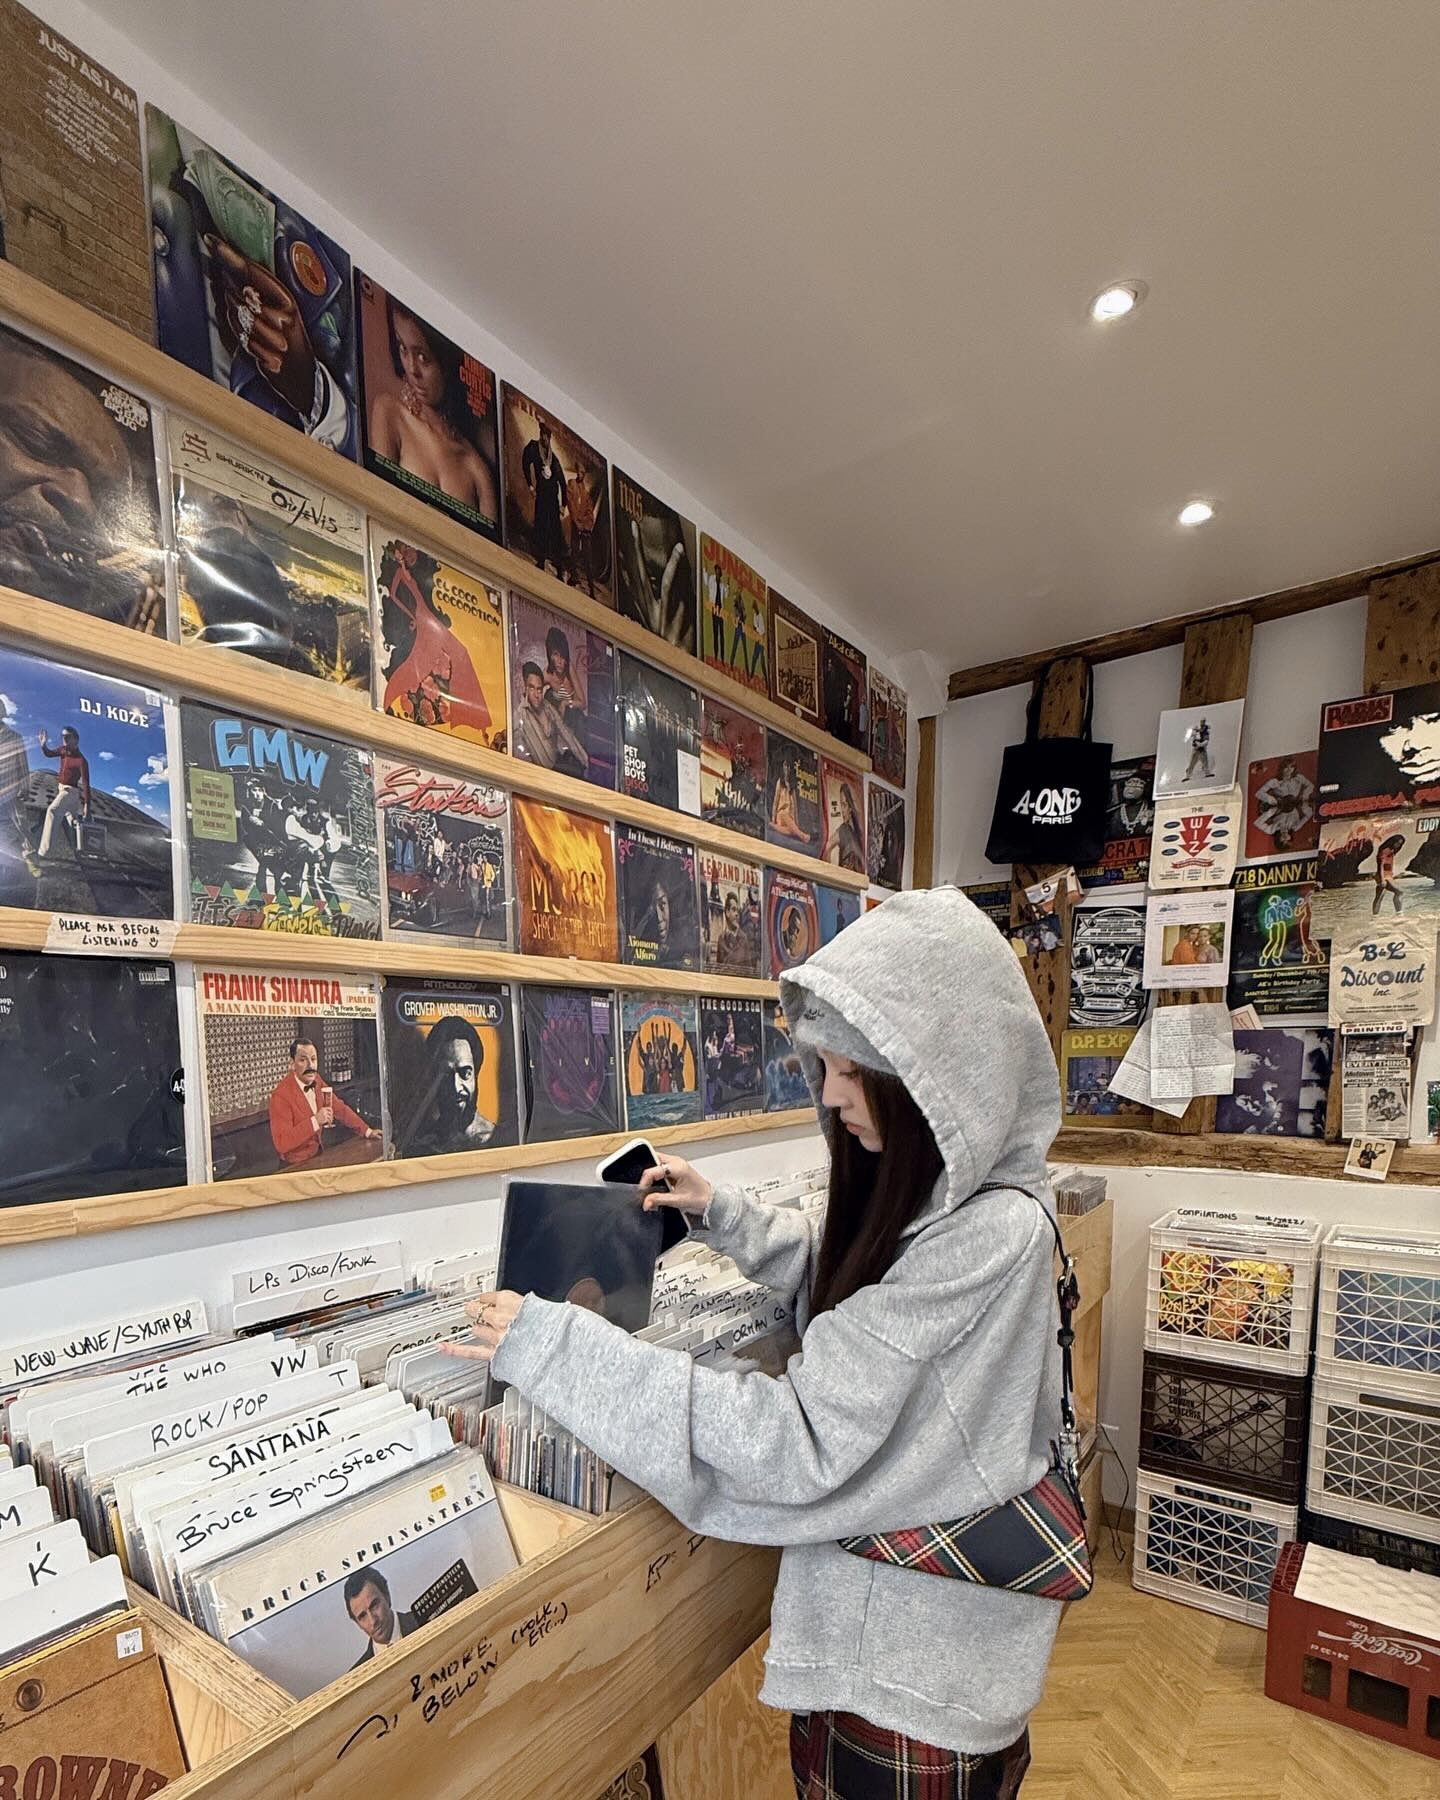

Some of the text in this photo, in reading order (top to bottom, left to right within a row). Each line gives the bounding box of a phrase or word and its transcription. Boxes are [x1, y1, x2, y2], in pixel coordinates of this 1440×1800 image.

[38, 30, 138, 114] JUST AS I AM
[436, 577, 479, 606] EL COCO
[79, 698, 150, 728] DJ KOZE
[623, 744, 638, 759] PET
[623, 755, 647, 771] SHOP
[624, 765, 646, 782] BOYS
[1011, 787, 1082, 816] A-ONE
[1188, 817, 1204, 853] WIZ
[1235, 869, 1257, 885] 718
[1257, 862, 1303, 887] DANNY
[58, 918, 160, 937] PLEASE ASK BEFORE
[203, 972, 268, 1003] FRANK
[270, 976, 343, 1005] SINATRA
[1340, 963, 1426, 988] Discount
[206, 1003, 320, 1017] A MAN AND HIS MUSIC
[404, 1001, 436, 1017] GROVER
[701, 998, 761, 1012] THE GOOD SON
[1345, 1025, 1403, 1034] PRINTING
[249, 1275, 281, 1293] LPs
[323, 1288, 340, 1302] C
[14, 1350, 57, 1377] NEW
[329, 1368, 349, 1387] T
[126, 1360, 227, 1397] THE WHO
[150, 1392, 268, 1452] ROCK/POP
[208, 1416, 332, 1482] SANTANA
[175, 1441, 414, 1554] Bruce Springsteen
[28, 1552, 58, 1587] K
[241, 1489, 487, 1623] BRUCE SPRINGSTEEN
[429, 1636, 493, 1688] MORE
[421, 1651, 499, 1723] BELOW
